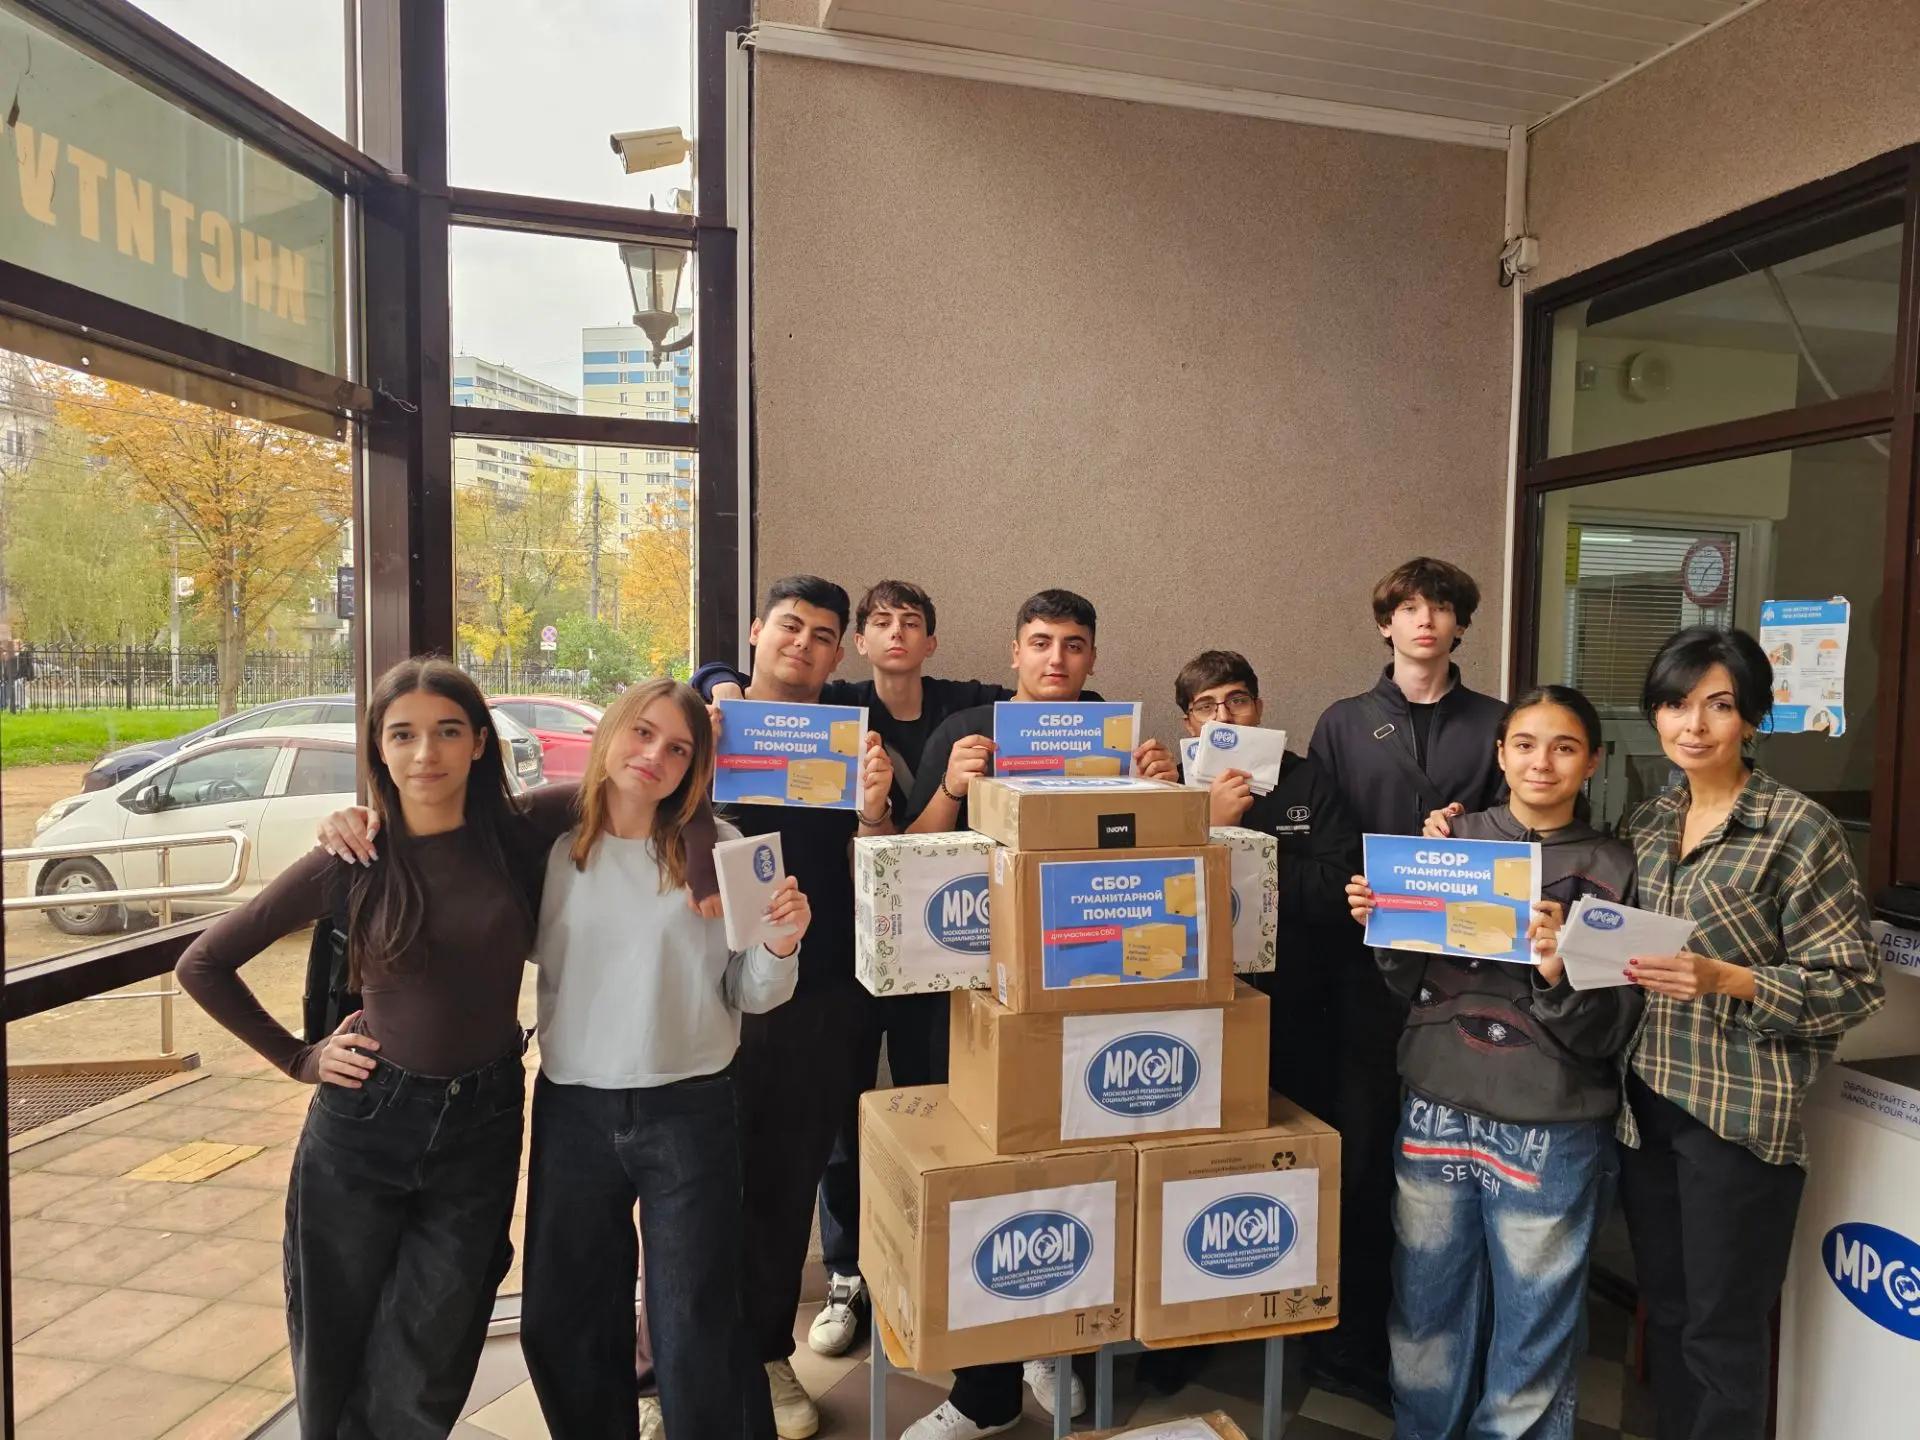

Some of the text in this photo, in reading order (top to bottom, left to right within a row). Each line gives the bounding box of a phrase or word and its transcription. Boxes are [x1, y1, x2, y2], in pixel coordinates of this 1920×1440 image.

[764, 714, 810, 728] СБОР
[1039, 714, 1084, 727] СБОР
[744, 728, 829, 740] ГУМАНИТАРНОЙ
[1020, 727, 1102, 737] ГУМАНИТАРНОЙ
[754, 740, 818, 754] ПОМОЩИ
[1031, 741, 1092, 752] ПОМОЩИ
[1415, 851, 1469, 866] СБОР
[1393, 865, 1492, 880] ГУМАНИТАРНОЙ
[1091, 875, 1142, 891] СБОР
[1405, 879, 1479, 896] ПОМОЩИ
[1070, 889, 1163, 905] ГУМАНИТАРНОЙ
[1083, 906, 1152, 921] ПОМОЩИ
[1103, 1046, 1184, 1089] МРСЭИ
[1843, 1081, 1909, 1109] ОБРАБОТАЙТЕ
[1841, 1091, 1876, 1111] HANDLE
[1878, 1104, 1903, 1119] YOUR
[1441, 1163, 1501, 1198] SEVEN
[1201, 1206, 1280, 1252] МРСЭИ
[992, 1222, 1075, 1274] МРСЭИ
